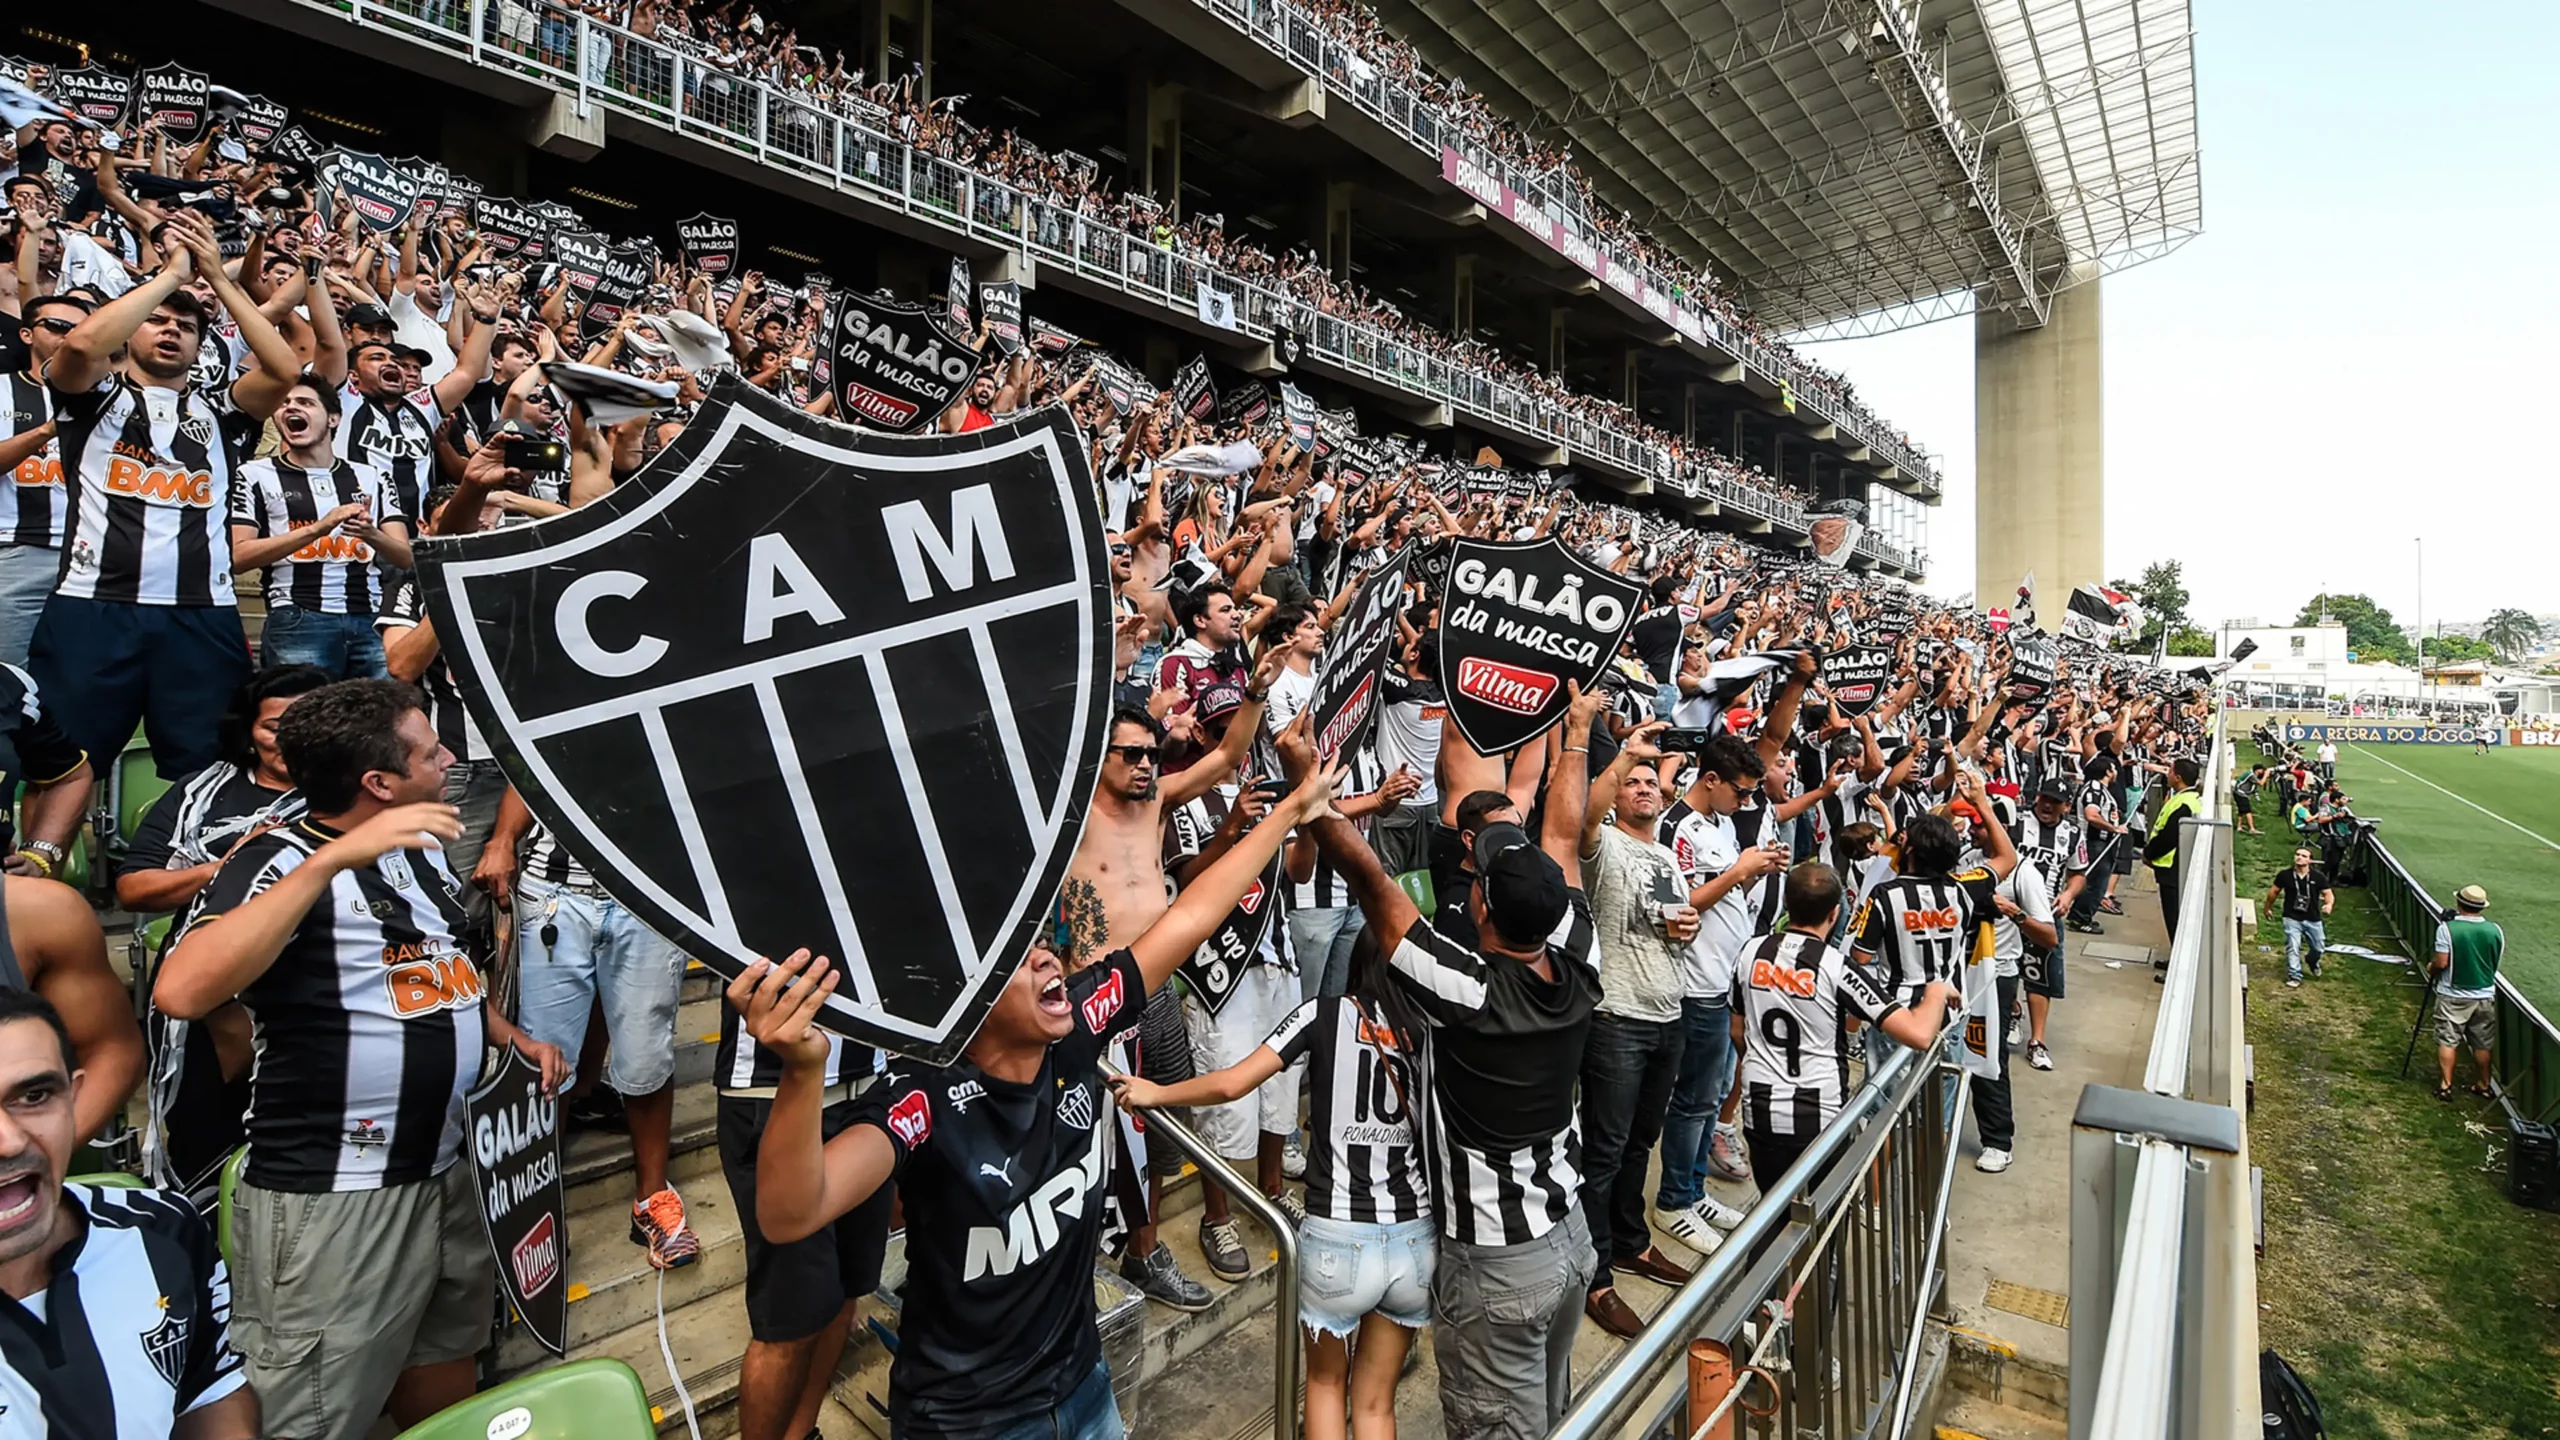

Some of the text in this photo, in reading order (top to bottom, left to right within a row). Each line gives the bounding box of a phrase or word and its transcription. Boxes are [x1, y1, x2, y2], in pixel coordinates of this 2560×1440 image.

[60, 72, 129, 94] GALÃO
[68, 87, 126, 102] da massa
[145, 72, 207, 93] GALÃO
[83, 105, 116, 117] Vilma
[150, 92, 204, 106] da massa
[159, 112, 195, 127] Vilma
[250, 114, 281, 128] massa
[338, 153, 416, 197] GALÃO
[450, 180, 481, 193] ALÃO
[1456, 159, 1502, 206] BRAHMA
[340, 170, 410, 208] da massa
[355, 198, 392, 222] Vilma
[477, 200, 538, 227] GALÃO
[1514, 198, 1553, 241] BRAHMA
[479, 214, 495, 226] da
[495, 218, 532, 238] massa
[680, 221, 736, 240] GALÃO
[485, 233, 516, 249] Vilma
[558, 236, 608, 262] GALÃ
[686, 239, 735, 251] da massa
[1563, 232, 1598, 271] BRAHMA
[561, 251, 604, 273] da mas
[605, 258, 647, 286] GALÃO
[700, 257, 727, 269] Vilma
[571, 271, 596, 289] Vilm
[986, 302, 1001, 314] da
[843, 309, 970, 385] GALÃO
[186, 363, 226, 385] RV
[839, 340, 871, 368] da
[875, 359, 949, 402] massa
[1177, 361, 1206, 402] GALÃO
[850, 386, 908, 423] Vilma
[362, 428, 432, 458] MRV
[1342, 439, 1380, 465] GALÃO
[15, 457, 67, 485] BM
[107, 458, 213, 505] BMG
[1466, 471, 1506, 483] GALÃO
[232, 468, 249, 515] MRV
[380, 470, 401, 509] MRV
[288, 519, 316, 530] BAN
[293, 535, 369, 560] BMG
[1761, 554, 1793, 564] GALÃO
[554, 481, 1017, 679] CAM
[1801, 584, 1818, 594] GAL
[1453, 557, 1627, 634] GALÃO
[1858, 620, 1879, 633] LÃO
[1880, 612, 1909, 623] GALÃO
[1450, 600, 1601, 670] da massa
[1332, 616, 1391, 694] massa
[1823, 650, 1888, 671] GALÃO
[2015, 645, 2056, 671] GALÃO
[1462, 661, 1544, 707] Vilma
[1827, 668, 1884, 682] da massa
[1838, 687, 1871, 700] Vilma
[1322, 689, 1368, 753] Vilma
[2309, 728, 2476, 744] A REGRA DO JOGO
[2521, 731, 2560, 745] BRA
[2019, 844, 2068, 866] MRV
[1903, 907, 1958, 931] BMG
[382, 940, 441, 966] BANCO
[390, 954, 487, 1016] BM
[1752, 959, 1816, 998] BMG
[1841, 970, 1881, 1008] MRV
[1274, 1010, 1302, 1039] MRV
[1760, 1007, 1803, 1077] 9
[1354, 1048, 1410, 1125] 10
[1060, 1087, 1085, 1115] CAM
[475, 1081, 556, 1170] GALÃO
[488, 1151, 558, 1223] da massa
[515, 1235, 556, 1291] Vilma
[151, 1321, 189, 1348] CAM
